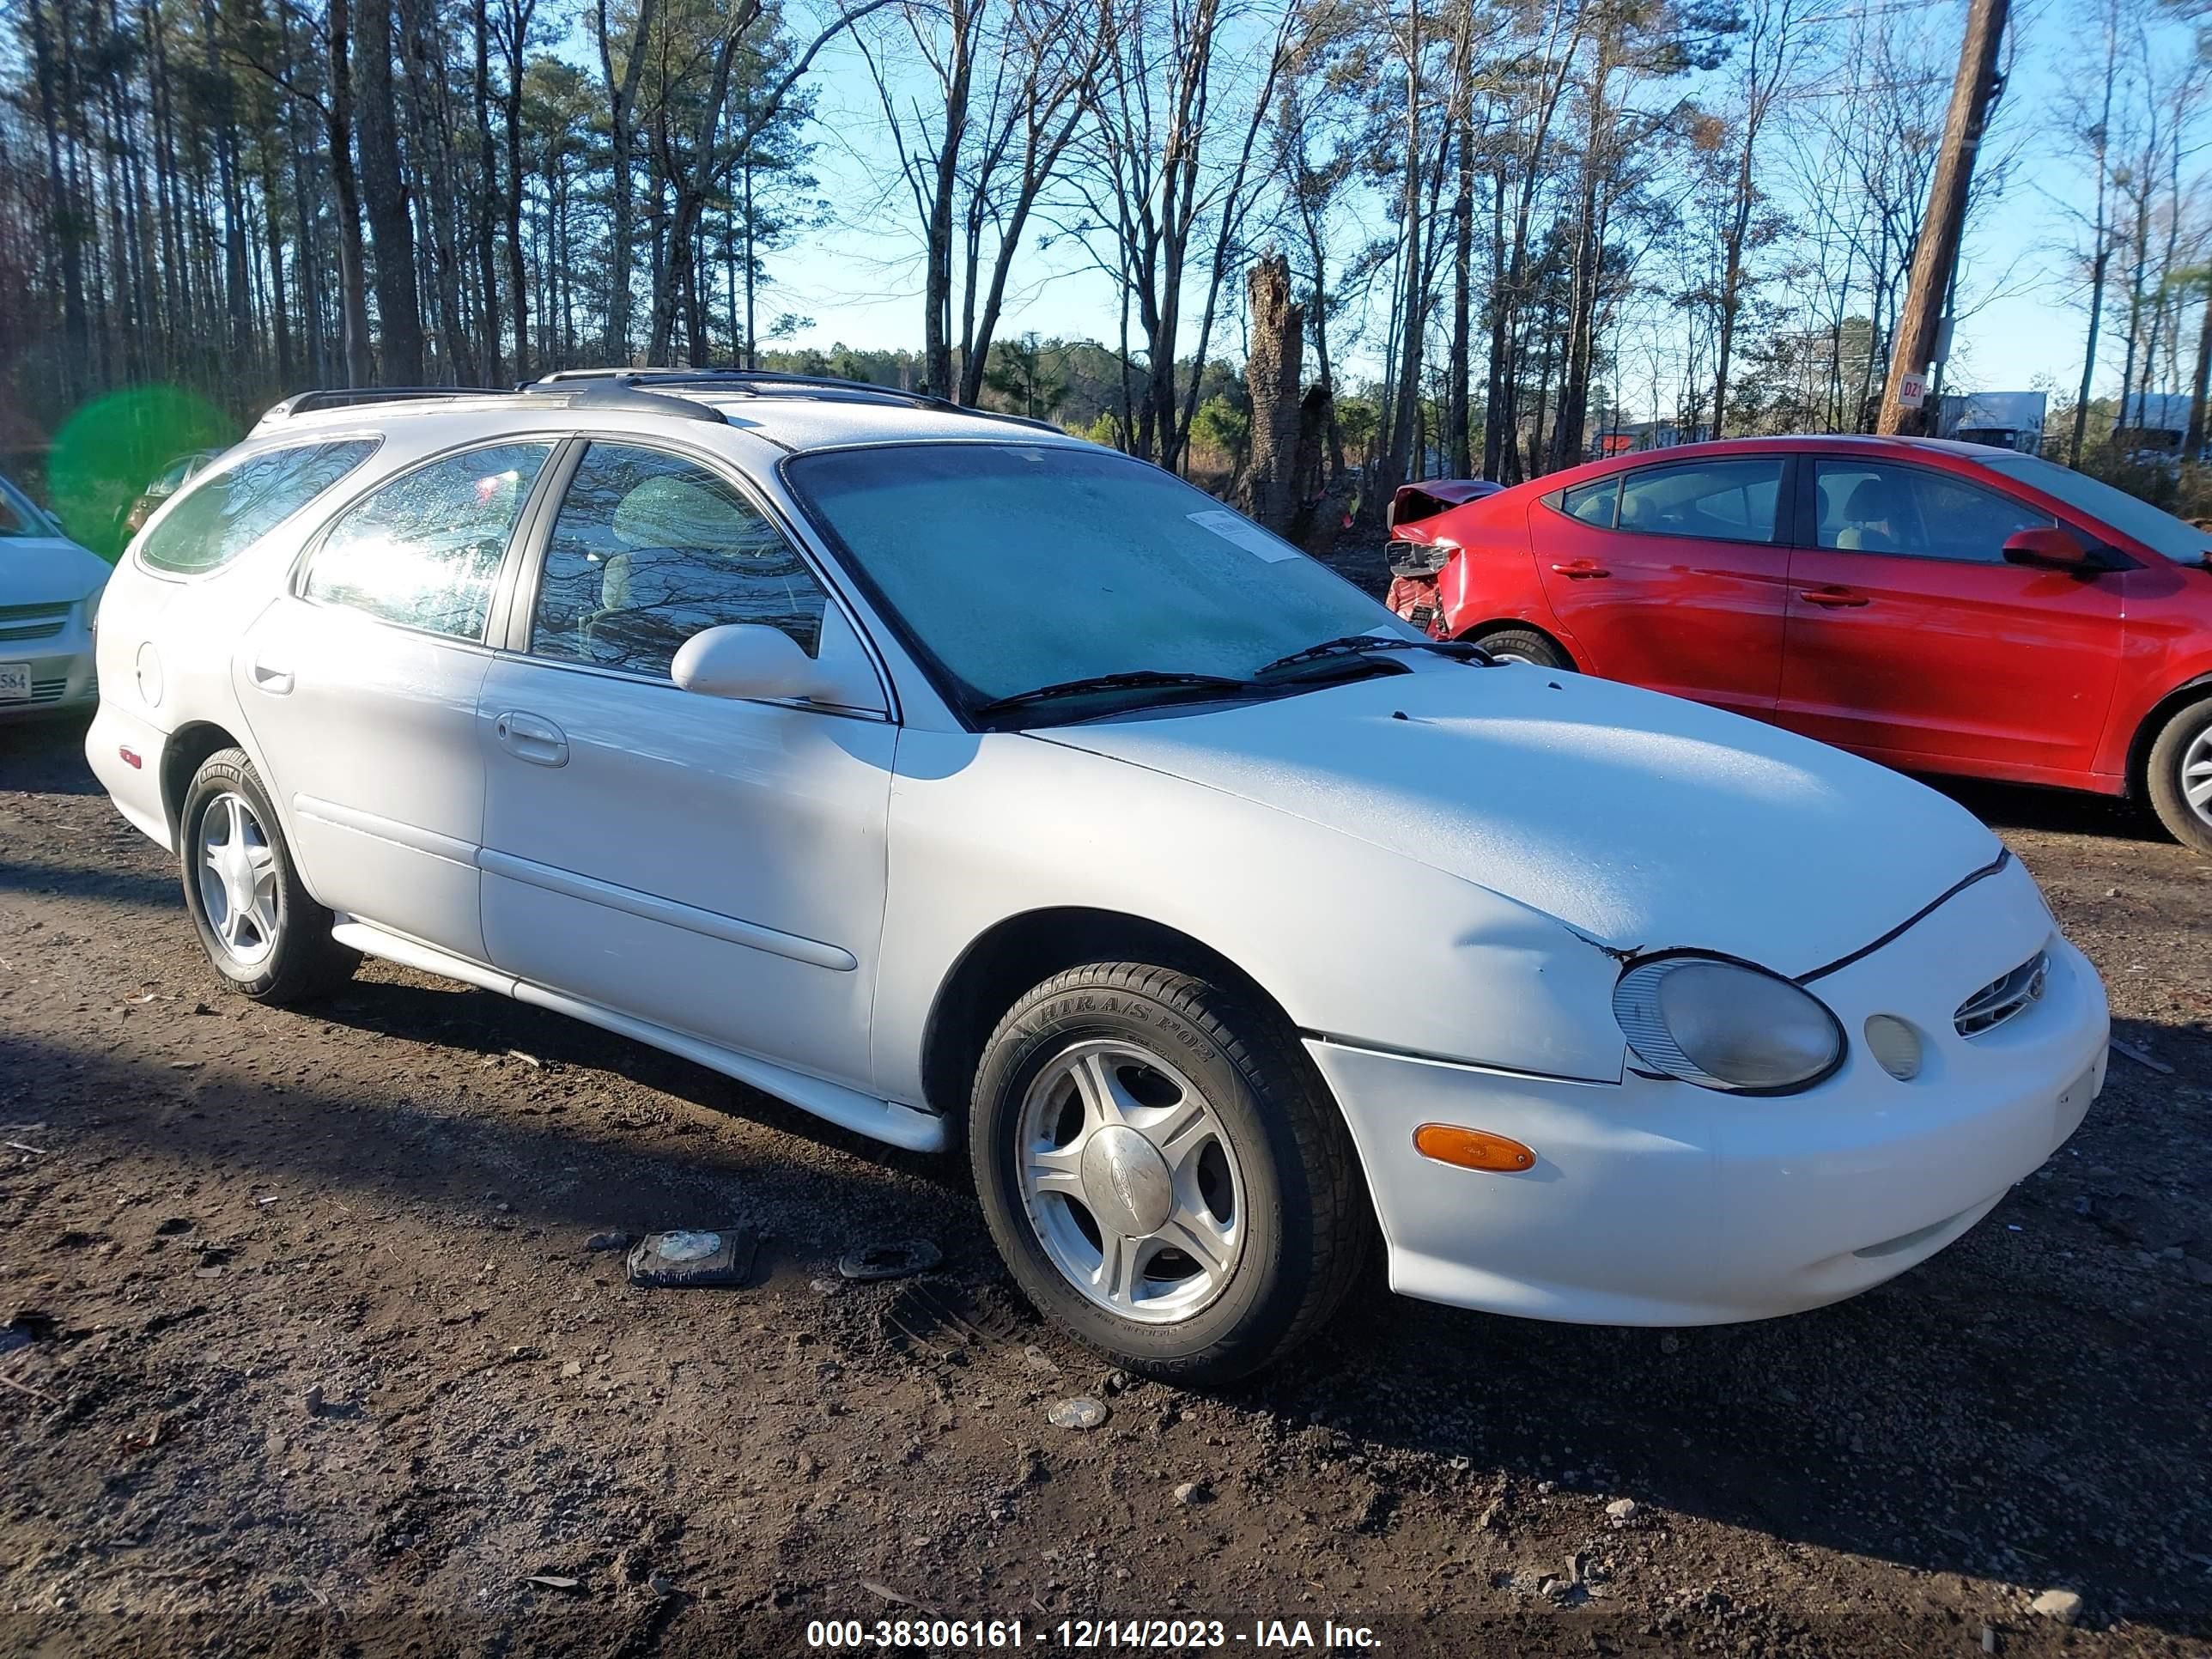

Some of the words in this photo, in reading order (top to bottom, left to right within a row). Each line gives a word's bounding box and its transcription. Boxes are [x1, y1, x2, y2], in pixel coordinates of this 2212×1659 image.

[1904, 381, 1923, 398] DZ1
[201, 764, 239, 783] ADVANTA
[1039, 995, 1096, 1026] HTR
[1099, 996, 1153, 1022] A/S
